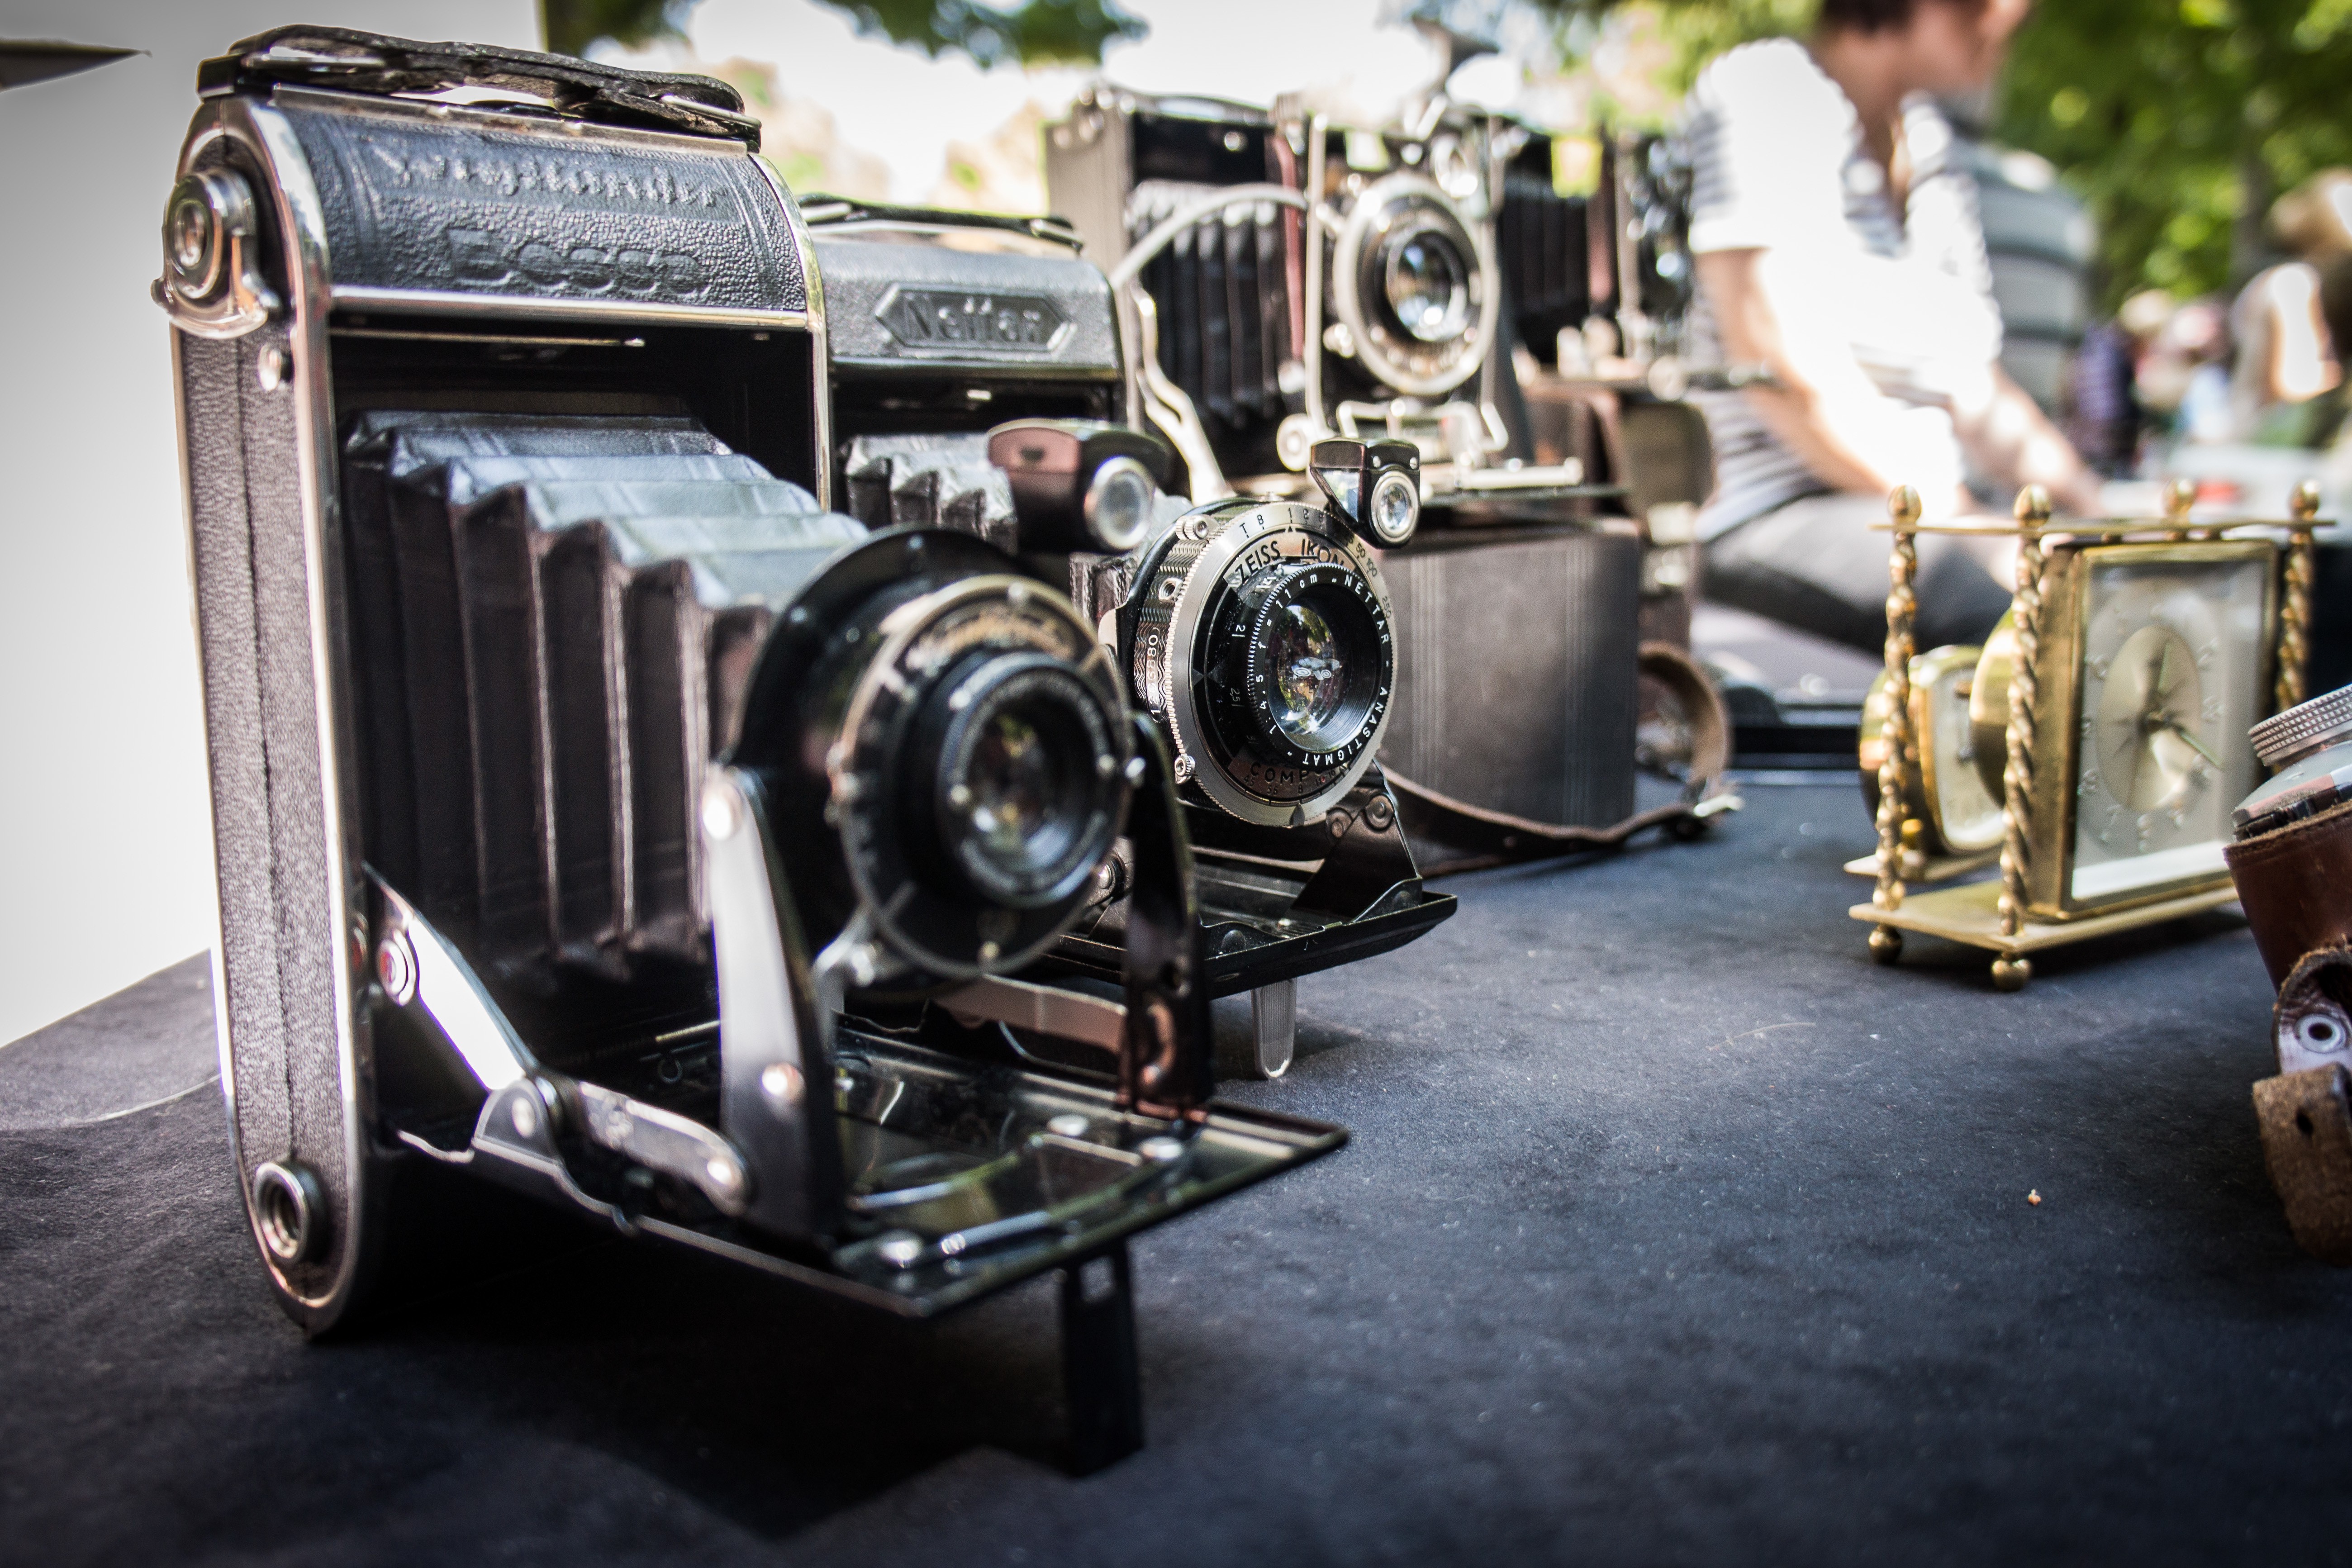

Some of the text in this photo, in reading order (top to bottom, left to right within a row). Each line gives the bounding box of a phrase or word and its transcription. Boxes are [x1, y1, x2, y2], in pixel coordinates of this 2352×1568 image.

[1235, 540, 1280, 585] ZEISS
[1239, 522, 1247, 534] T
[1257, 514, 1264, 525] B
[1288, 507, 1292, 518] 1
[1367, 558, 1378, 577] 100
[1382, 596, 1392, 619] 250
